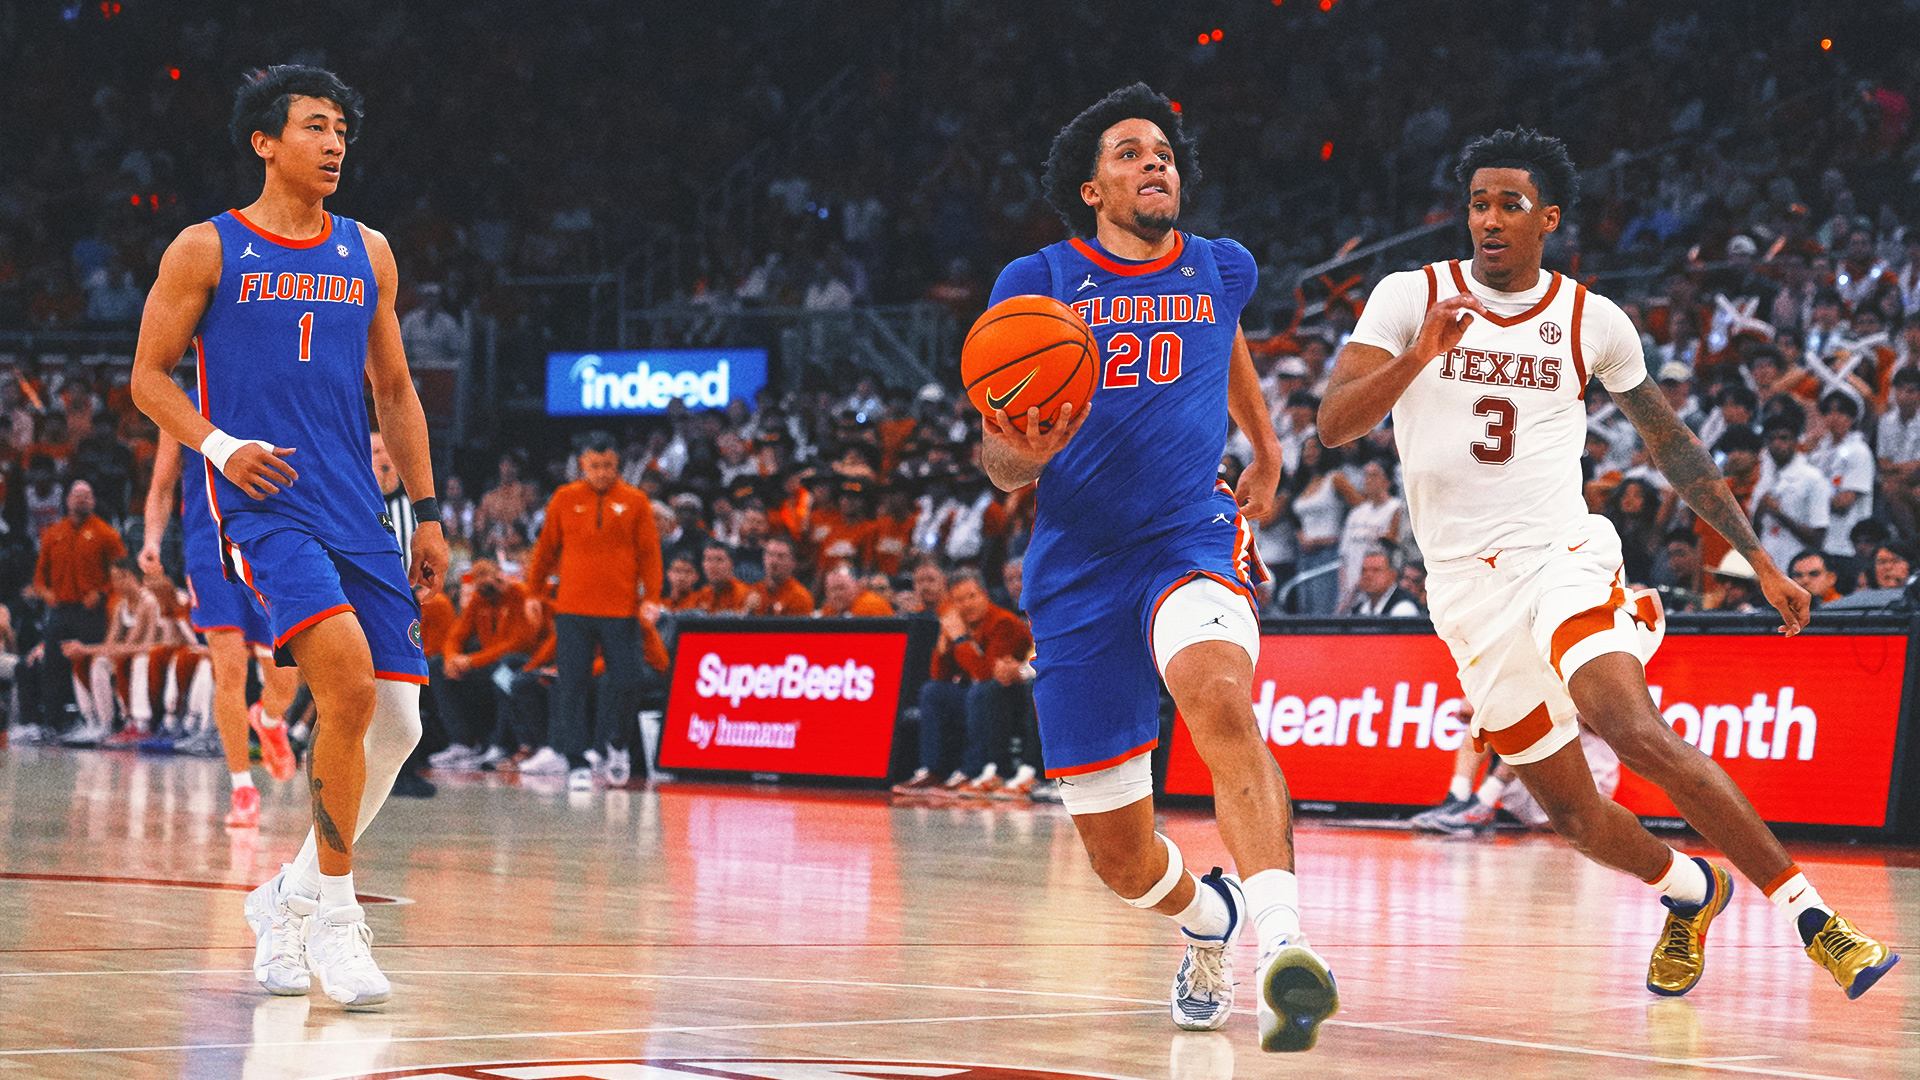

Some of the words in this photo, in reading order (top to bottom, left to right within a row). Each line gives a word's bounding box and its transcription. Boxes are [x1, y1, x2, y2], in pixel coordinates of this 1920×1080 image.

[236, 272, 364, 306] FLORIDA
[298, 312, 314, 362] 1
[1540, 323, 1562, 344] SEC
[578, 358, 730, 409] indeed
[1102, 331, 1183, 389] 20
[1439, 346, 1562, 391] TEXAS
[1470, 395, 1518, 465] 3
[695, 652, 876, 708] SuperBeets
[687, 712, 716, 750] by
[1648, 685, 1817, 761] onth
